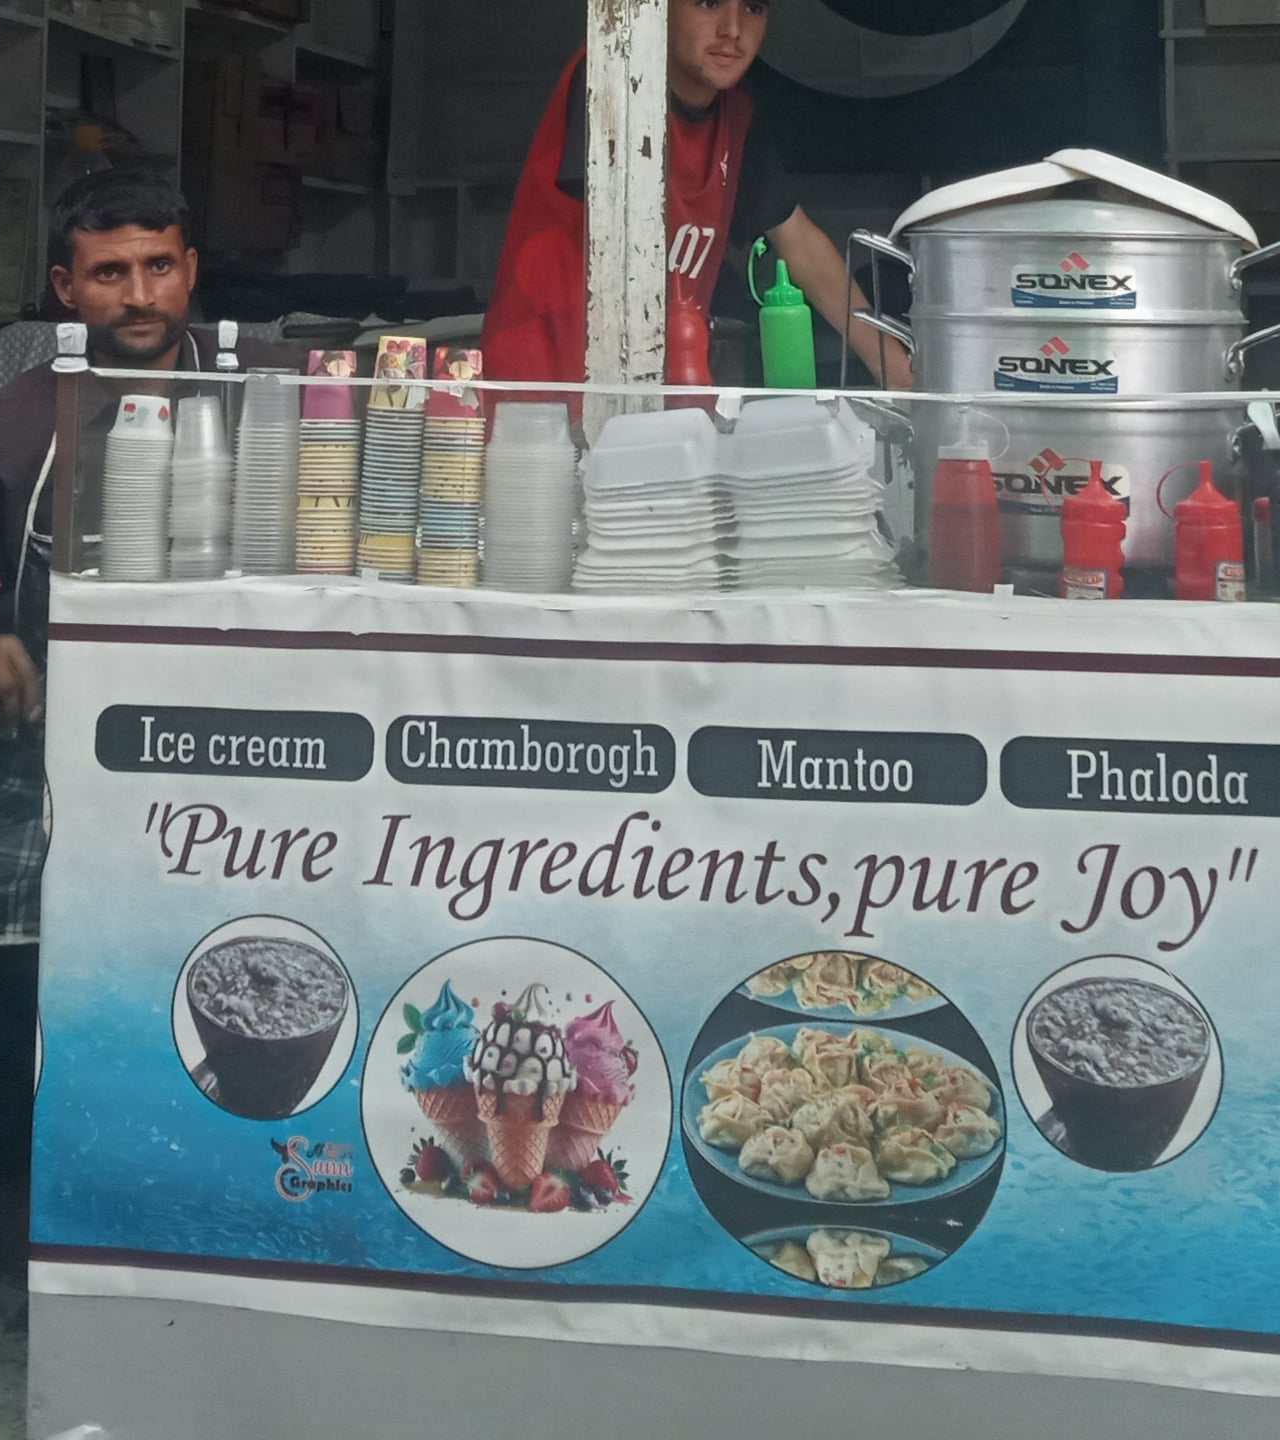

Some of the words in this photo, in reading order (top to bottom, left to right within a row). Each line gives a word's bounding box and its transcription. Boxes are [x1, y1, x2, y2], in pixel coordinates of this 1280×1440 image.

[1015, 272, 1134, 292] SONEX
[998, 355, 1116, 376] SONEX
[140, 716, 195, 763] Ice
[208, 730, 327, 770] cream
[401, 719, 659, 788] Chamborogh
[757, 739, 914, 793] Mantoo
[1066, 749, 1249, 805] Phaloda
[144, 802, 338, 883] "Pure
[1060, 843, 1259, 952] Joy"
